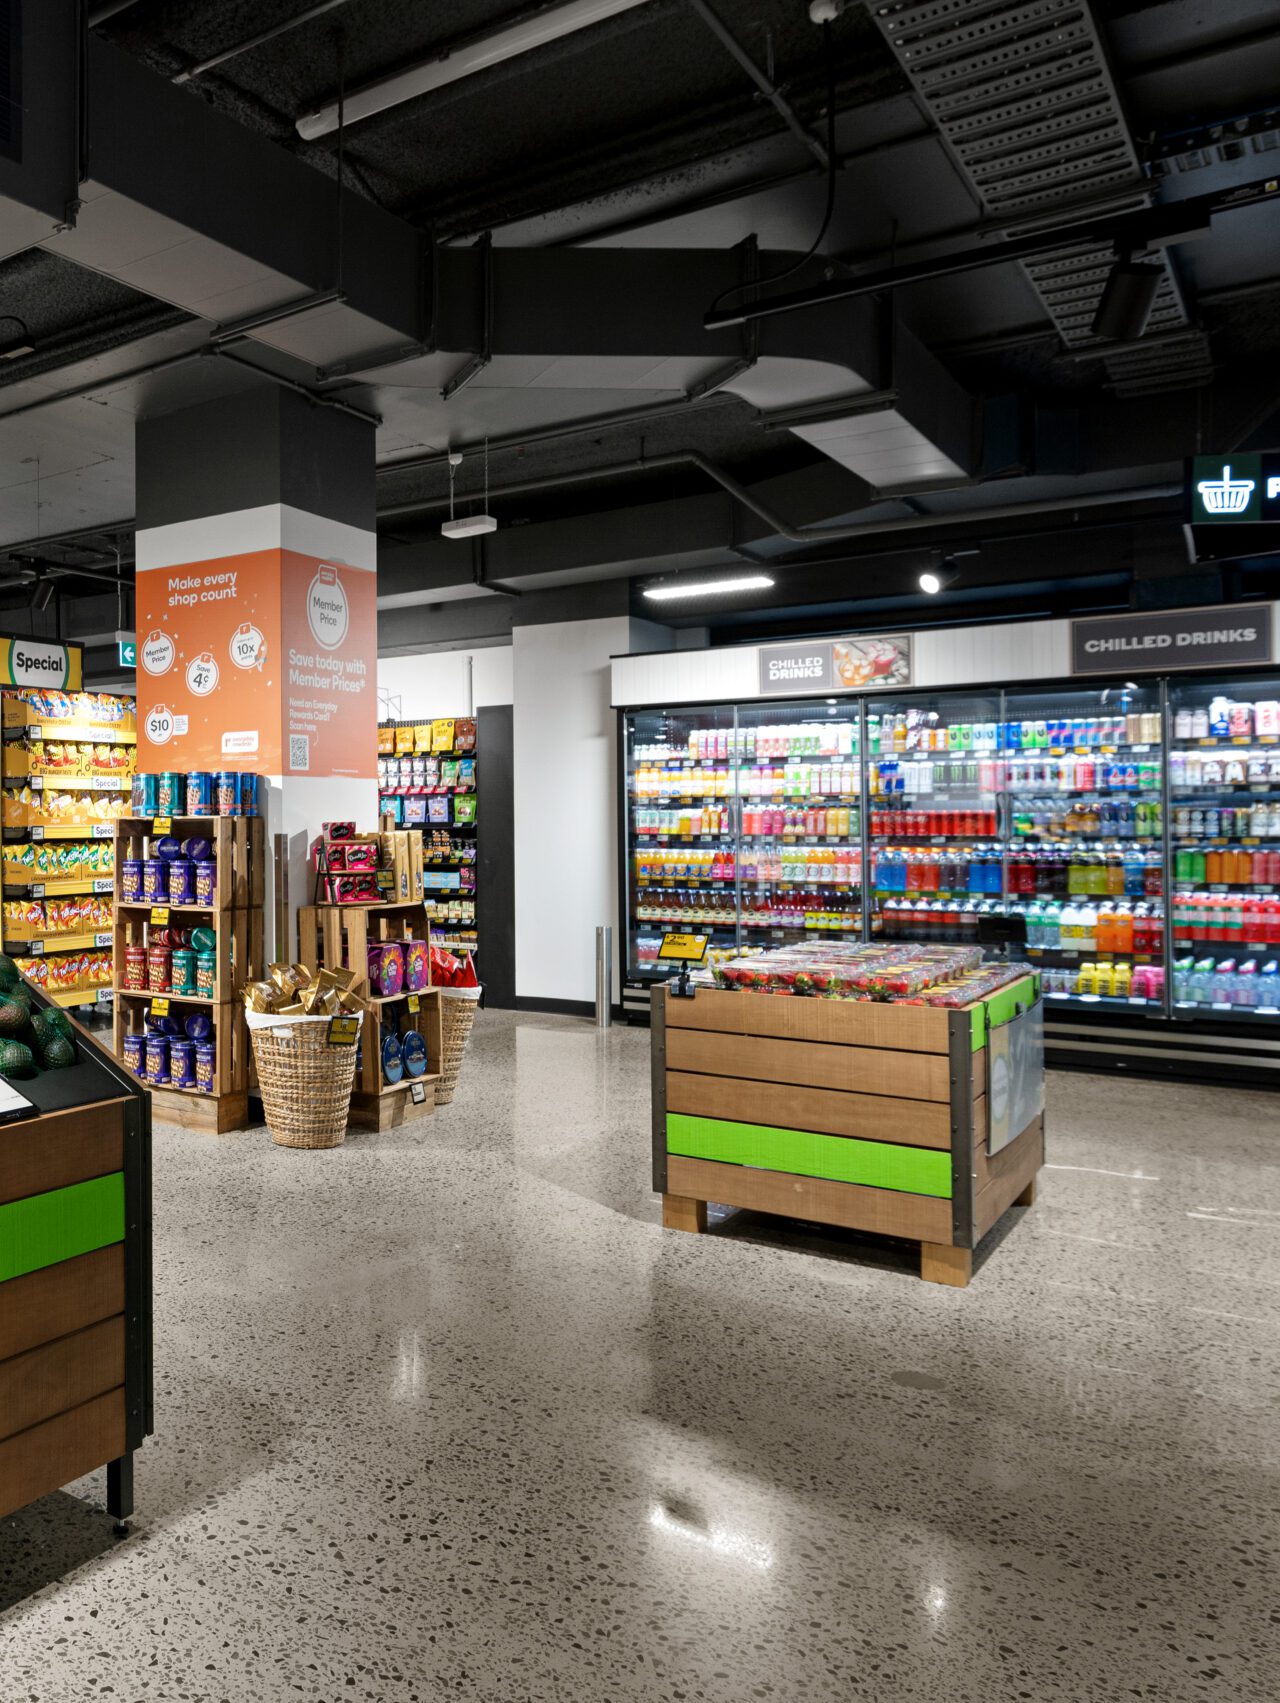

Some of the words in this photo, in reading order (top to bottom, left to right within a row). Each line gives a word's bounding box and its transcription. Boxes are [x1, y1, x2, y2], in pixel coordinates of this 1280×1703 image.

[168, 575, 201, 591] Make
[203, 571, 237, 586] every
[168, 592, 198, 607] shop
[200, 585, 237, 602] count
[313, 596, 343, 613] Member
[320, 613, 337, 626] Price
[1085, 634, 1172, 653] CHILLED
[1176, 628, 1257, 647] DRINKS
[145, 645, 170, 658] Member
[237, 643, 255, 656] 10x
[16, 652, 63, 673] Special
[151, 654, 166, 664] Price
[288, 649, 314, 668] Save
[315, 654, 344, 675] today
[345, 659, 366, 675] with
[768, 656, 823, 670] CHILLED
[196, 664, 210, 673] Save
[769, 666, 823, 680] DRINKS
[289, 668, 331, 689] Member
[289, 697, 304, 707] Need
[304, 700, 313, 708] an
[313, 699, 337, 713] Everyday
[289, 708, 313, 720] Rewards
[150, 719, 169, 732] $10
[289, 720, 304, 730] Scan
[95, 777, 118, 788] Special
[96, 826, 113, 836] Speci
[96, 880, 113, 891] Speci
